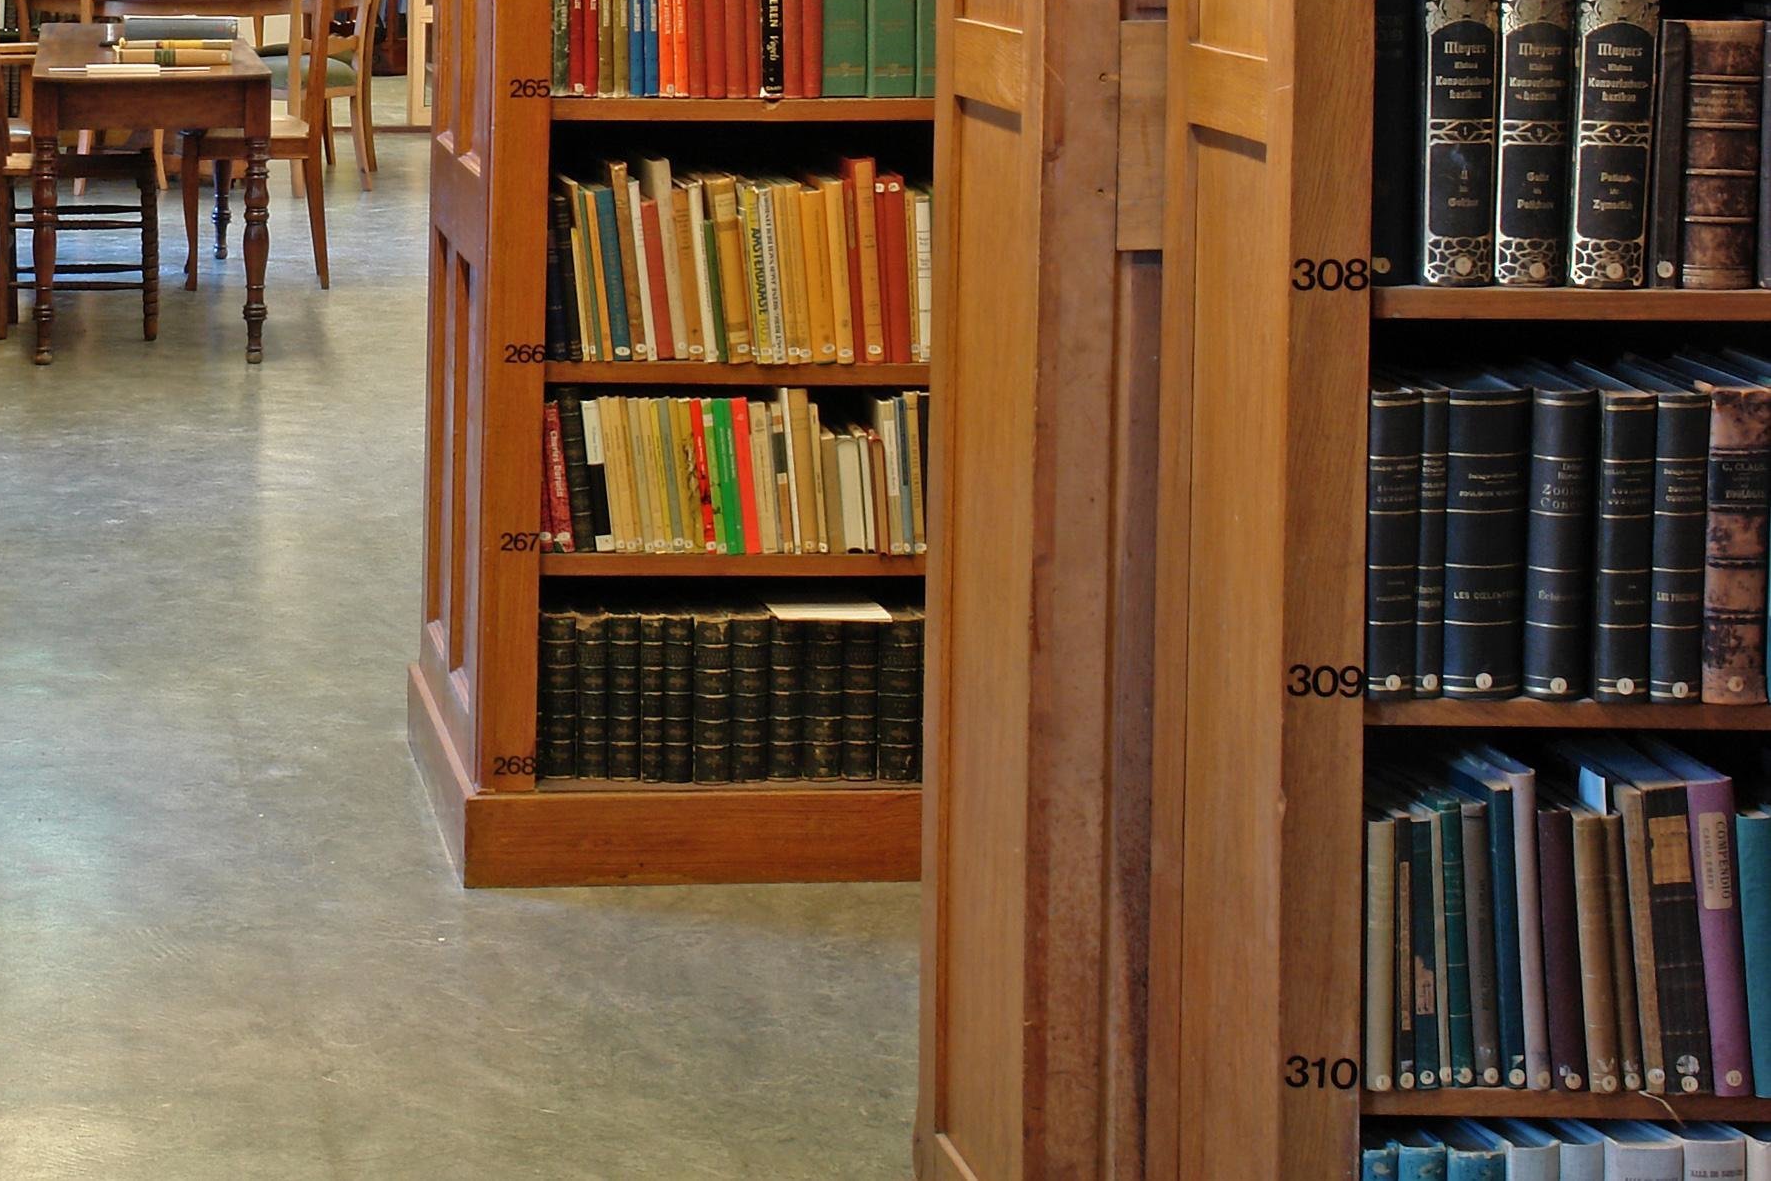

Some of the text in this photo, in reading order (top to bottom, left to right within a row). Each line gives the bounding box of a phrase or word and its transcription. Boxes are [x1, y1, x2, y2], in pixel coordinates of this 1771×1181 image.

[1444, 41, 1487, 57] Meyers
[1597, 42, 1643, 58] Meyers
[509, 79, 551, 99] 265
[751, 228, 768, 315] AMSTERDAMSE
[1292, 258, 1369, 292] 308
[504, 344, 546, 364] 266
[500, 532, 540, 552] 267
[1287, 664, 1365, 699] 309
[493, 755, 537, 776] 268
[1716, 821, 1731, 899] COMPENDIO
[1286, 1055, 1358, 1090] 310
